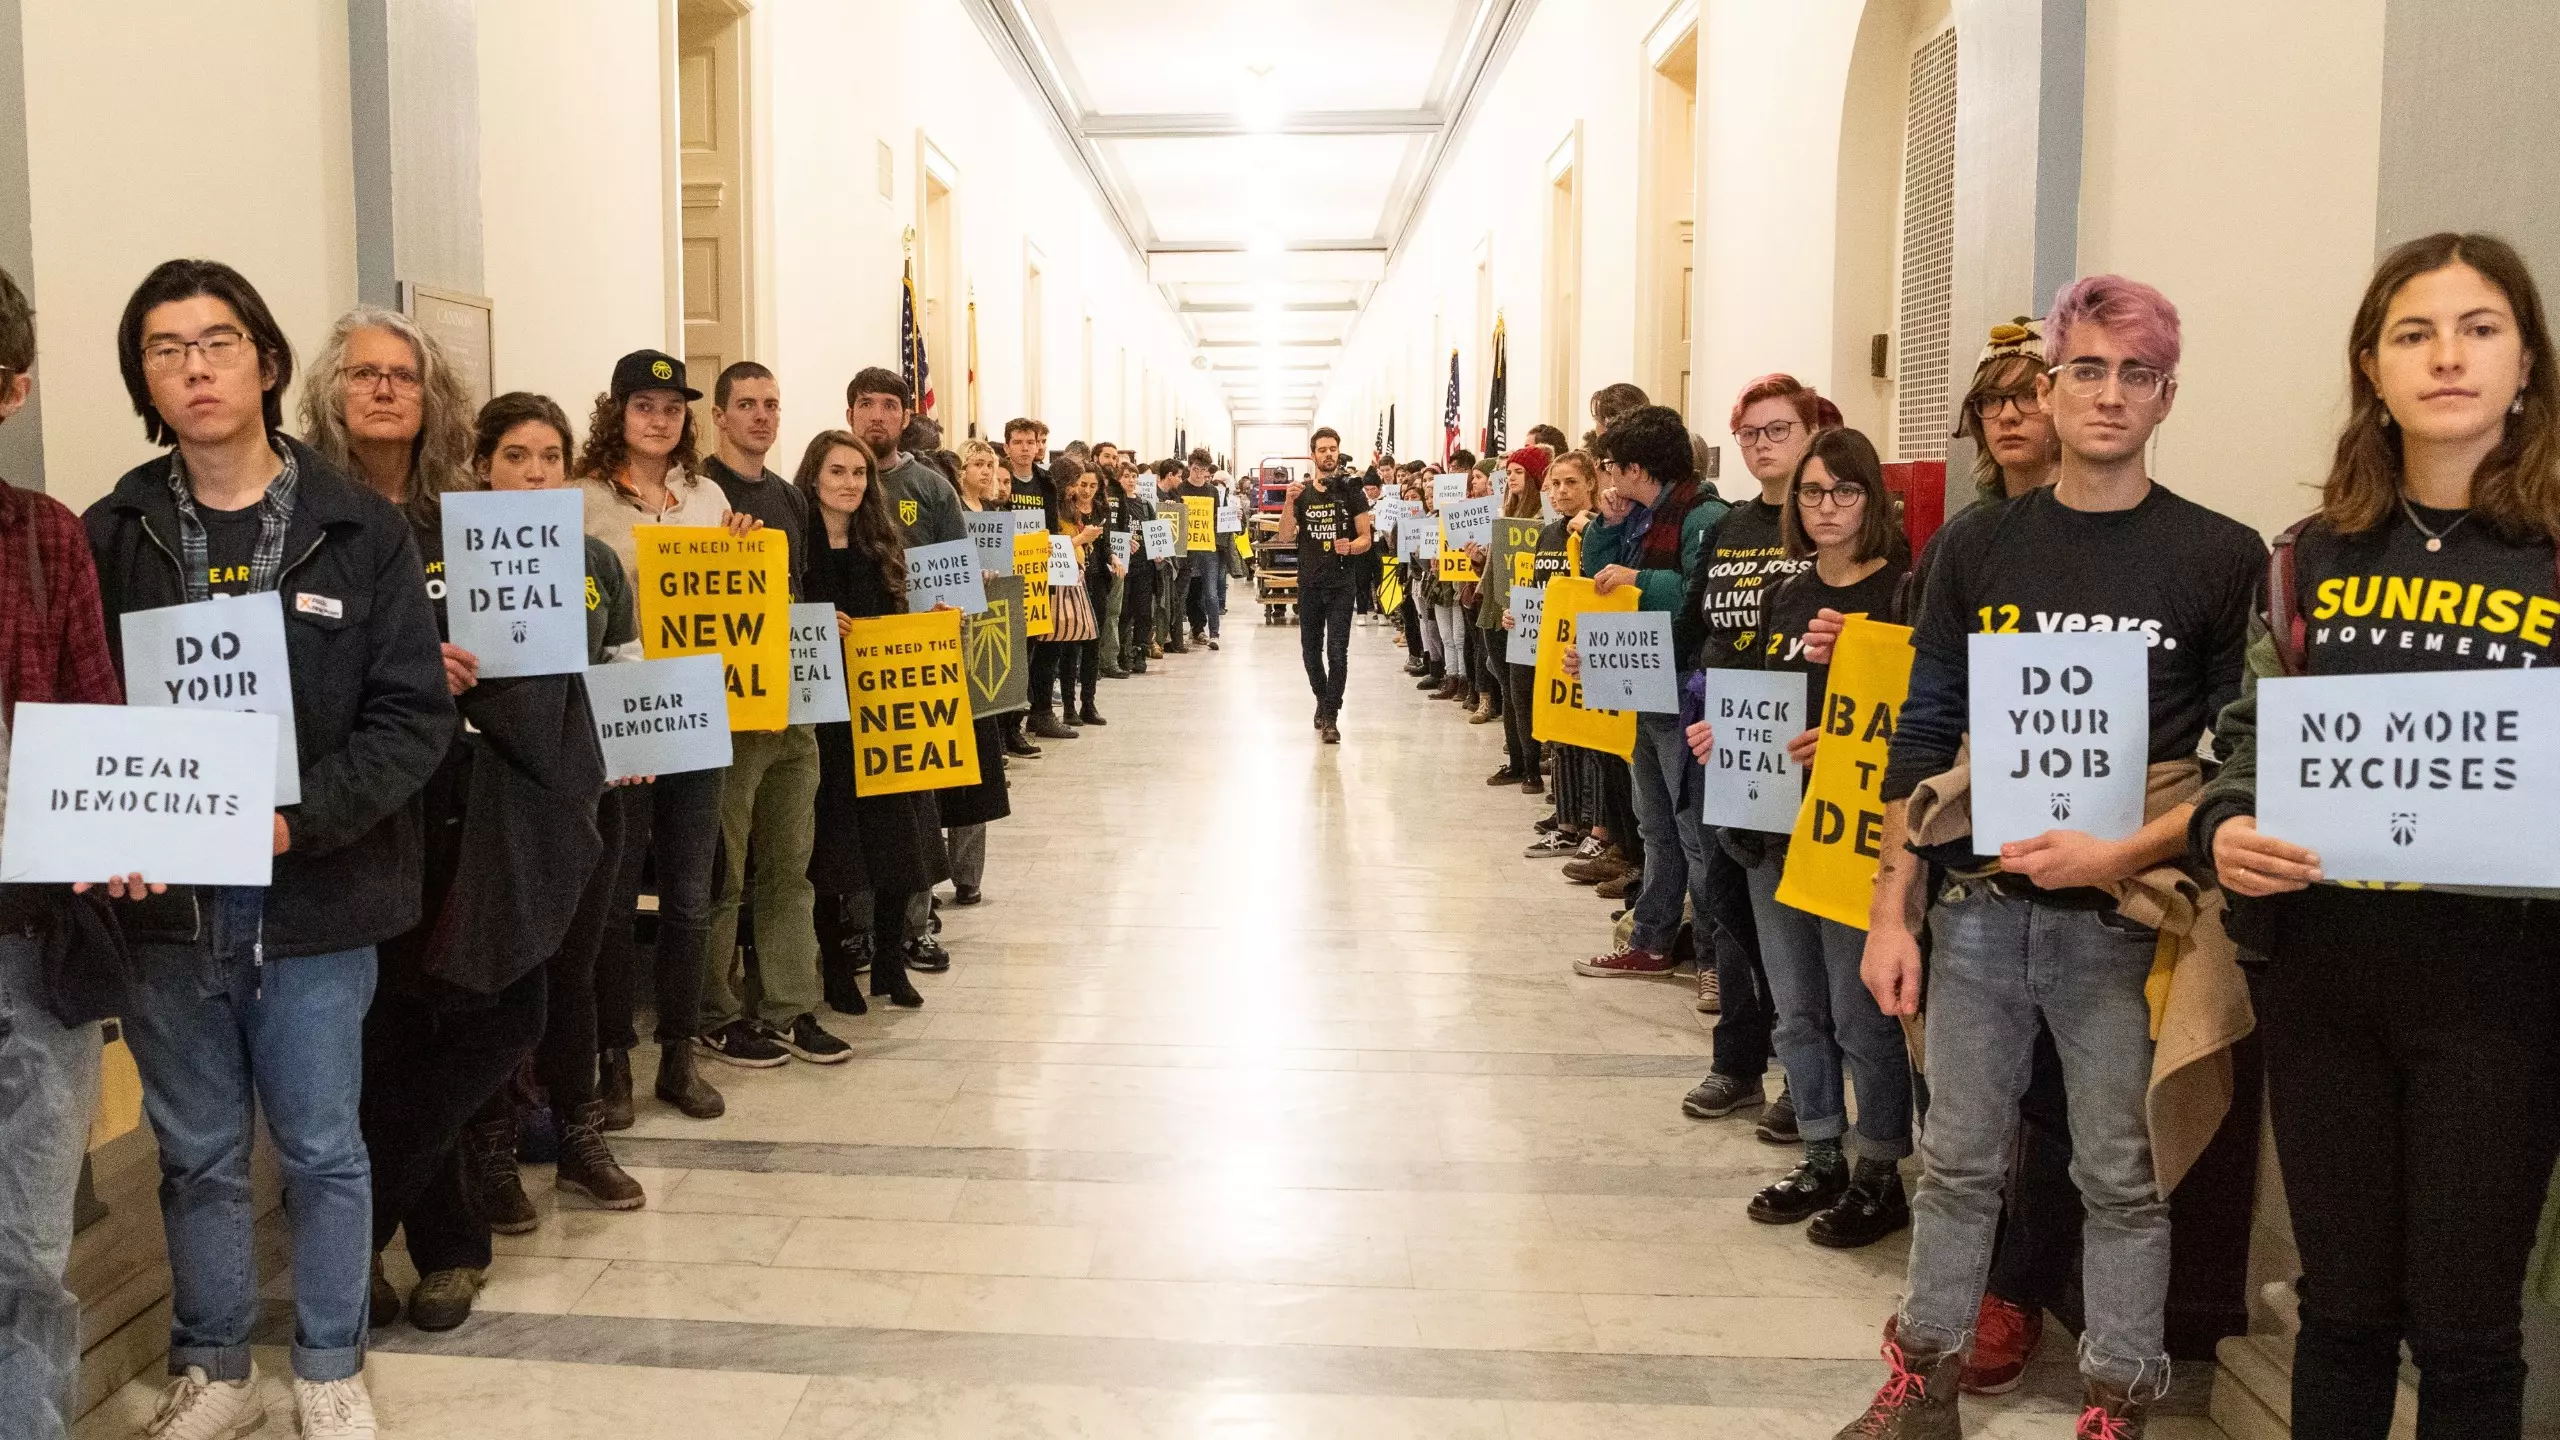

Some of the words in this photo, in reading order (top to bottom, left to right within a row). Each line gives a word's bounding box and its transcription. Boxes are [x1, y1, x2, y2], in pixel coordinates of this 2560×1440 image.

[1306, 510, 1328, 518] GOOD
[1448, 511, 1460, 520] NO
[1463, 505, 1490, 518] MORE
[968, 522, 1004, 534] MORE
[1016, 521, 1041, 529] BACK
[1450, 516, 1491, 531] EXCUSES
[465, 524, 561, 551] BACK
[1151, 539, 1168, 547] JOB
[1509, 527, 1538, 547] DO
[658, 541, 682, 555] WE
[688, 541, 730, 554] NEED
[737, 540, 766, 553] THE
[1717, 549, 1731, 557] WE
[1732, 548, 1758, 558] HAVE
[1759, 548, 1766, 556] A
[490, 557, 541, 576] THE
[927, 554, 969, 572] MORE
[1013, 561, 1048, 576] REEN
[1049, 561, 1070, 569] JOB
[1708, 561, 1758, 578] GOOD
[1759, 559, 1813, 574] JOBS
[209, 566, 250, 584] EAR
[659, 569, 767, 598] GREEN
[1734, 576, 1762, 588] AND
[469, 584, 563, 613] DEAL
[1024, 581, 1047, 599] EW
[1704, 594, 1712, 610] A
[2312, 575, 2560, 648] SUNRISE
[1025, 604, 1048, 622] EAL
[1521, 613, 1542, 624] YOU
[661, 612, 766, 649] NEW
[790, 625, 829, 642] ACK
[1520, 628, 1539, 639] JO
[1978, 604, 2021, 634] 12
[2035, 611, 2177, 650] years.
[176, 631, 242, 666] DO
[855, 645, 879, 658] WE
[884, 643, 923, 656] NEED
[929, 639, 958, 652] THE
[1589, 631, 1609, 647] NO
[1616, 631, 1659, 647] MORE
[2315, 626, 2537, 669] MOVEMENT
[790, 647, 818, 659] THE
[1589, 653, 1661, 669] EXCUSES
[724, 663, 767, 698] AL
[794, 663, 832, 682] EAL
[857, 662, 960, 692] GREEN
[2022, 665, 2093, 696] DO
[164, 670, 259, 704] YOUR
[622, 693, 684, 714] DEAR
[1720, 698, 1790, 722] BACK
[859, 697, 960, 734] NEW
[1826, 693, 1895, 746] BA
[2008, 709, 2109, 735] YOUR
[601, 712, 709, 739] DEMOCRATS
[2301, 712, 2362, 743] NO
[2385, 710, 2519, 743] MORE
[1735, 727, 1773, 744] THE
[863, 739, 964, 777] DEAL
[1719, 748, 1786, 775] DEAL
[2010, 747, 2111, 779] JOB
[96, 756, 201, 780] DEAR
[2300, 757, 2517, 790] EXCUSES
[51, 788, 240, 816] DEMOCRATS
[1812, 799, 1885, 860] DE
